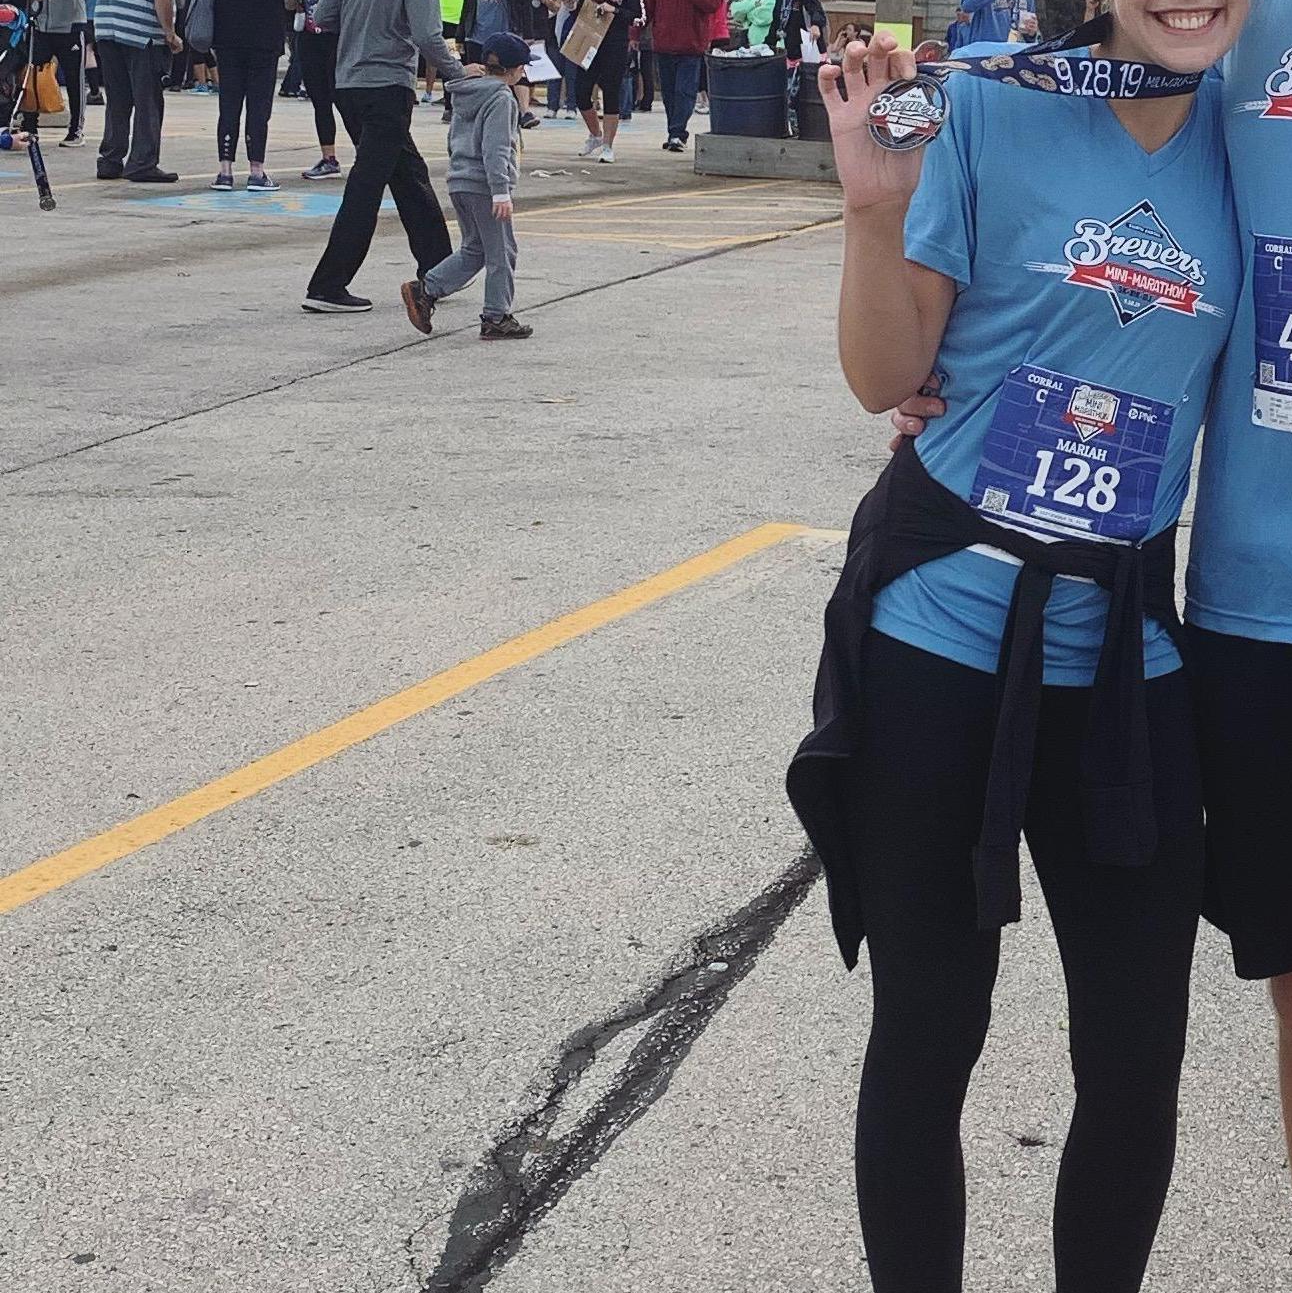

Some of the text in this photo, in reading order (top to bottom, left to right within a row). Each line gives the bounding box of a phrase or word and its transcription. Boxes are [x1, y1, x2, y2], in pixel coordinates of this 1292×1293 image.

[1054, 57, 1145, 98] 9.28.19
[869, 93, 945, 123] Brewers
[1063, 218, 1205, 284] Brewers
[1274, 256, 1283, 270] C
[1104, 265, 1188, 301] MINI-MARATHON
[1027, 373, 1064, 392] CORRAL
[1035, 389, 1049, 403] C
[1138, 410, 1158, 425] PNC
[1056, 438, 1108, 462] MARIAH
[1026, 449, 1121, 513] 128
